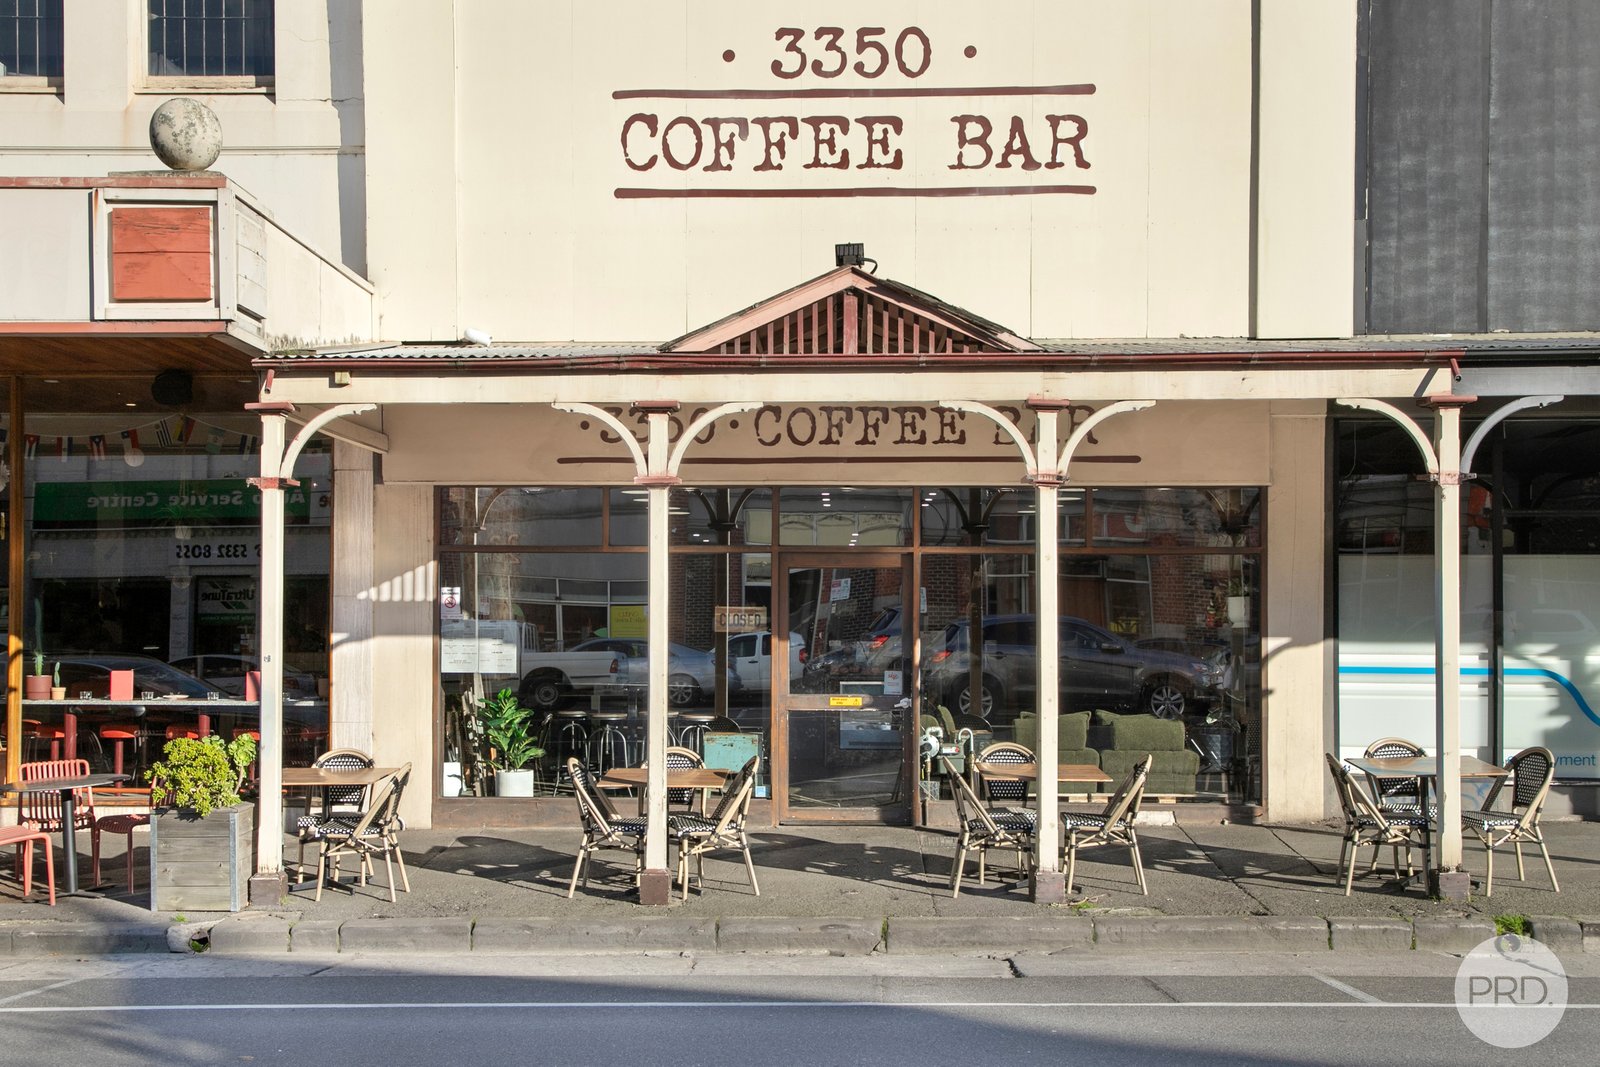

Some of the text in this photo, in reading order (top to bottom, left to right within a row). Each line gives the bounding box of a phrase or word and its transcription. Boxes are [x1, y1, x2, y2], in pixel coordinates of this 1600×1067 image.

[771, 27, 931, 79] 3350
[621, 113, 1091, 172] COFFEE BAR
[754, 405, 966, 446] COFFEE
[992, 405, 1099, 445] BR
[720, 613, 761, 626] CLOSED
